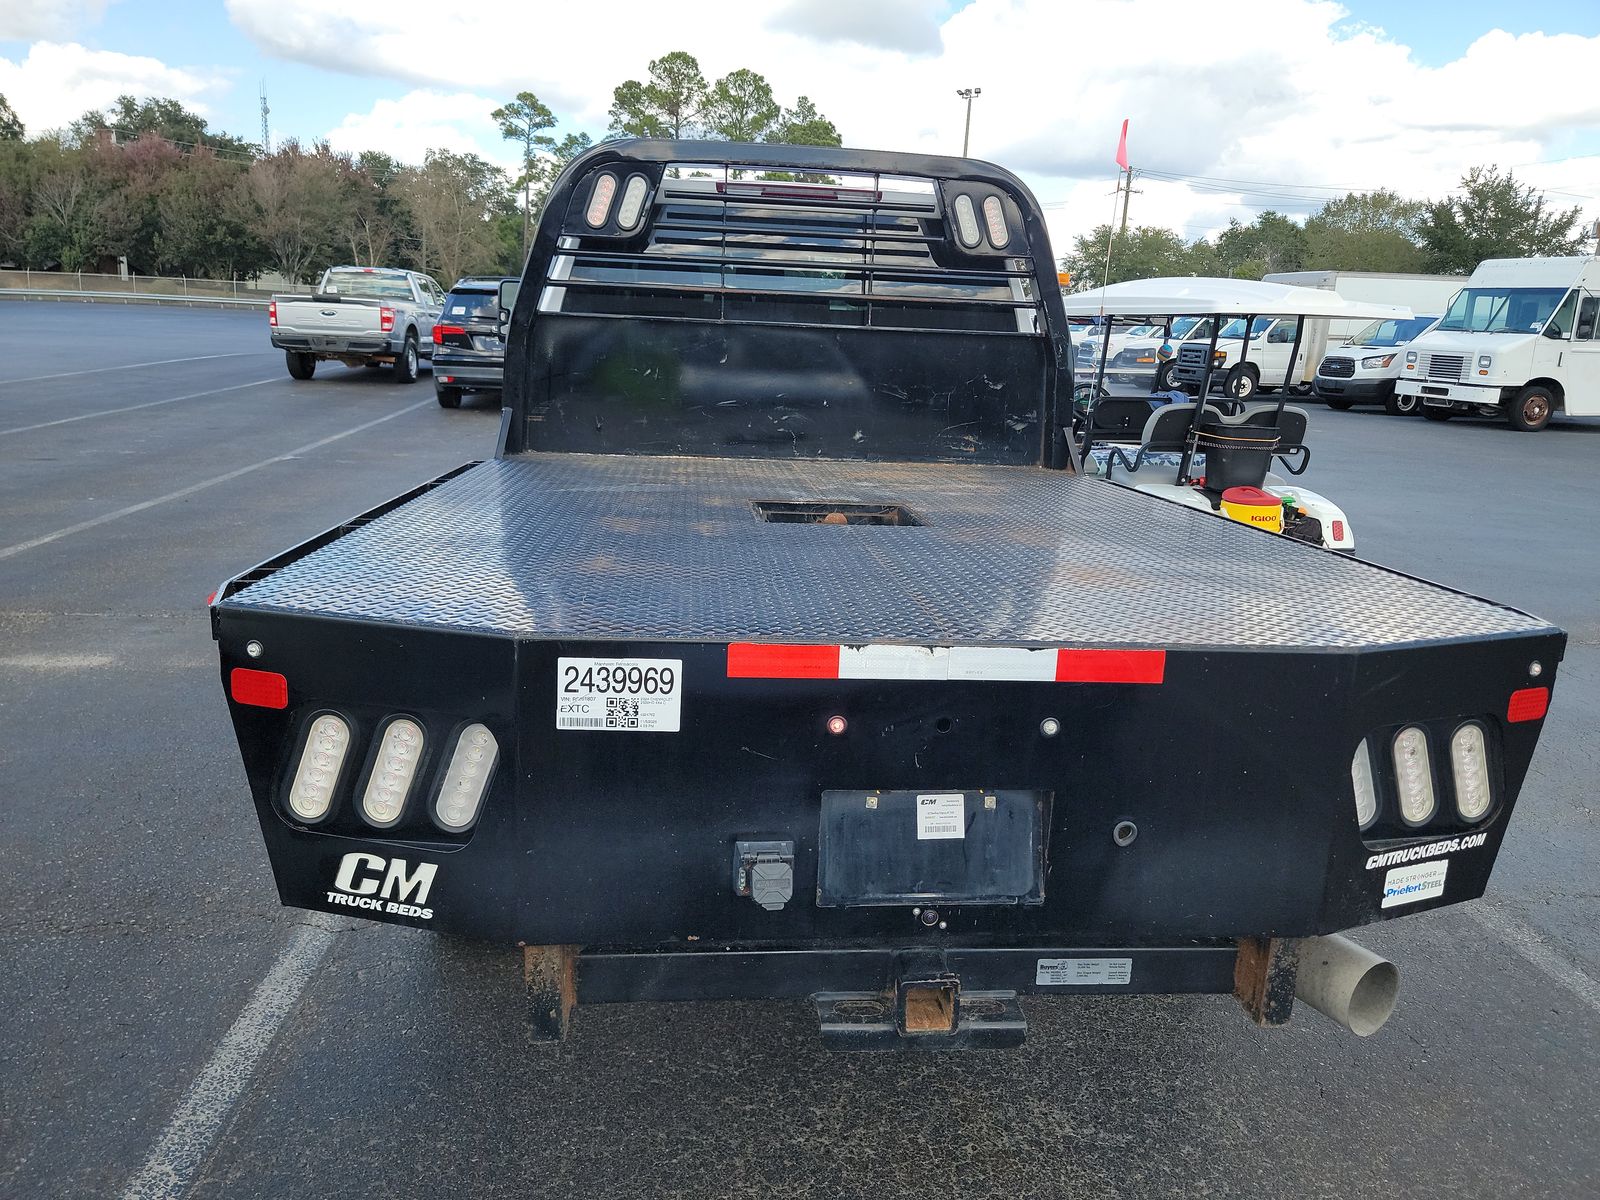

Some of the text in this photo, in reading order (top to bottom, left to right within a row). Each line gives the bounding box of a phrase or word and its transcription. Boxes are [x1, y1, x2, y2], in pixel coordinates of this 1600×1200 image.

[564, 666, 674, 694] 2439969
[560, 704, 590, 714] EXTC
[1365, 832, 1488, 870] CMTRUCKBEDS.COM
[334, 852, 439, 905] CM
[1405, 870, 1438, 883] STRONGER
[326, 891, 434, 920] TRUCK BEDS
